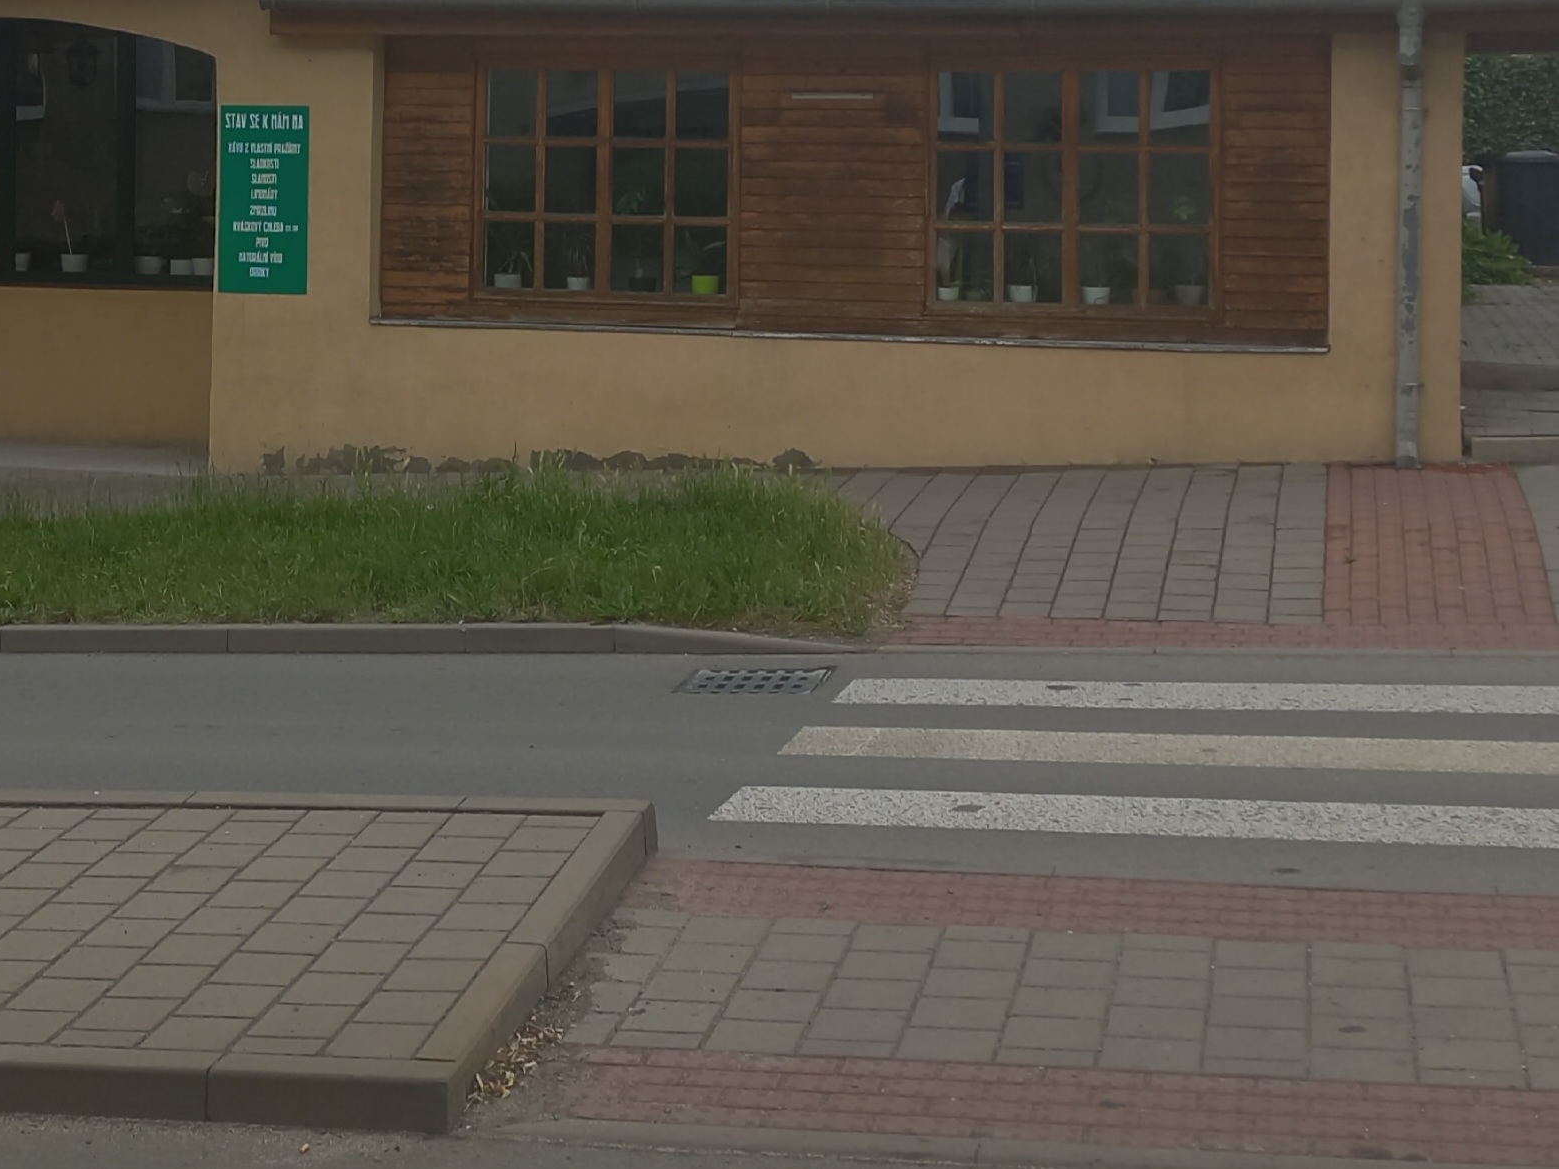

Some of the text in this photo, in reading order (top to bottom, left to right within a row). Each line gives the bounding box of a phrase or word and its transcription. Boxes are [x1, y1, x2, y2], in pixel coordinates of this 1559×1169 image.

[225, 111, 303, 130] STAV SE K NÁM NA
